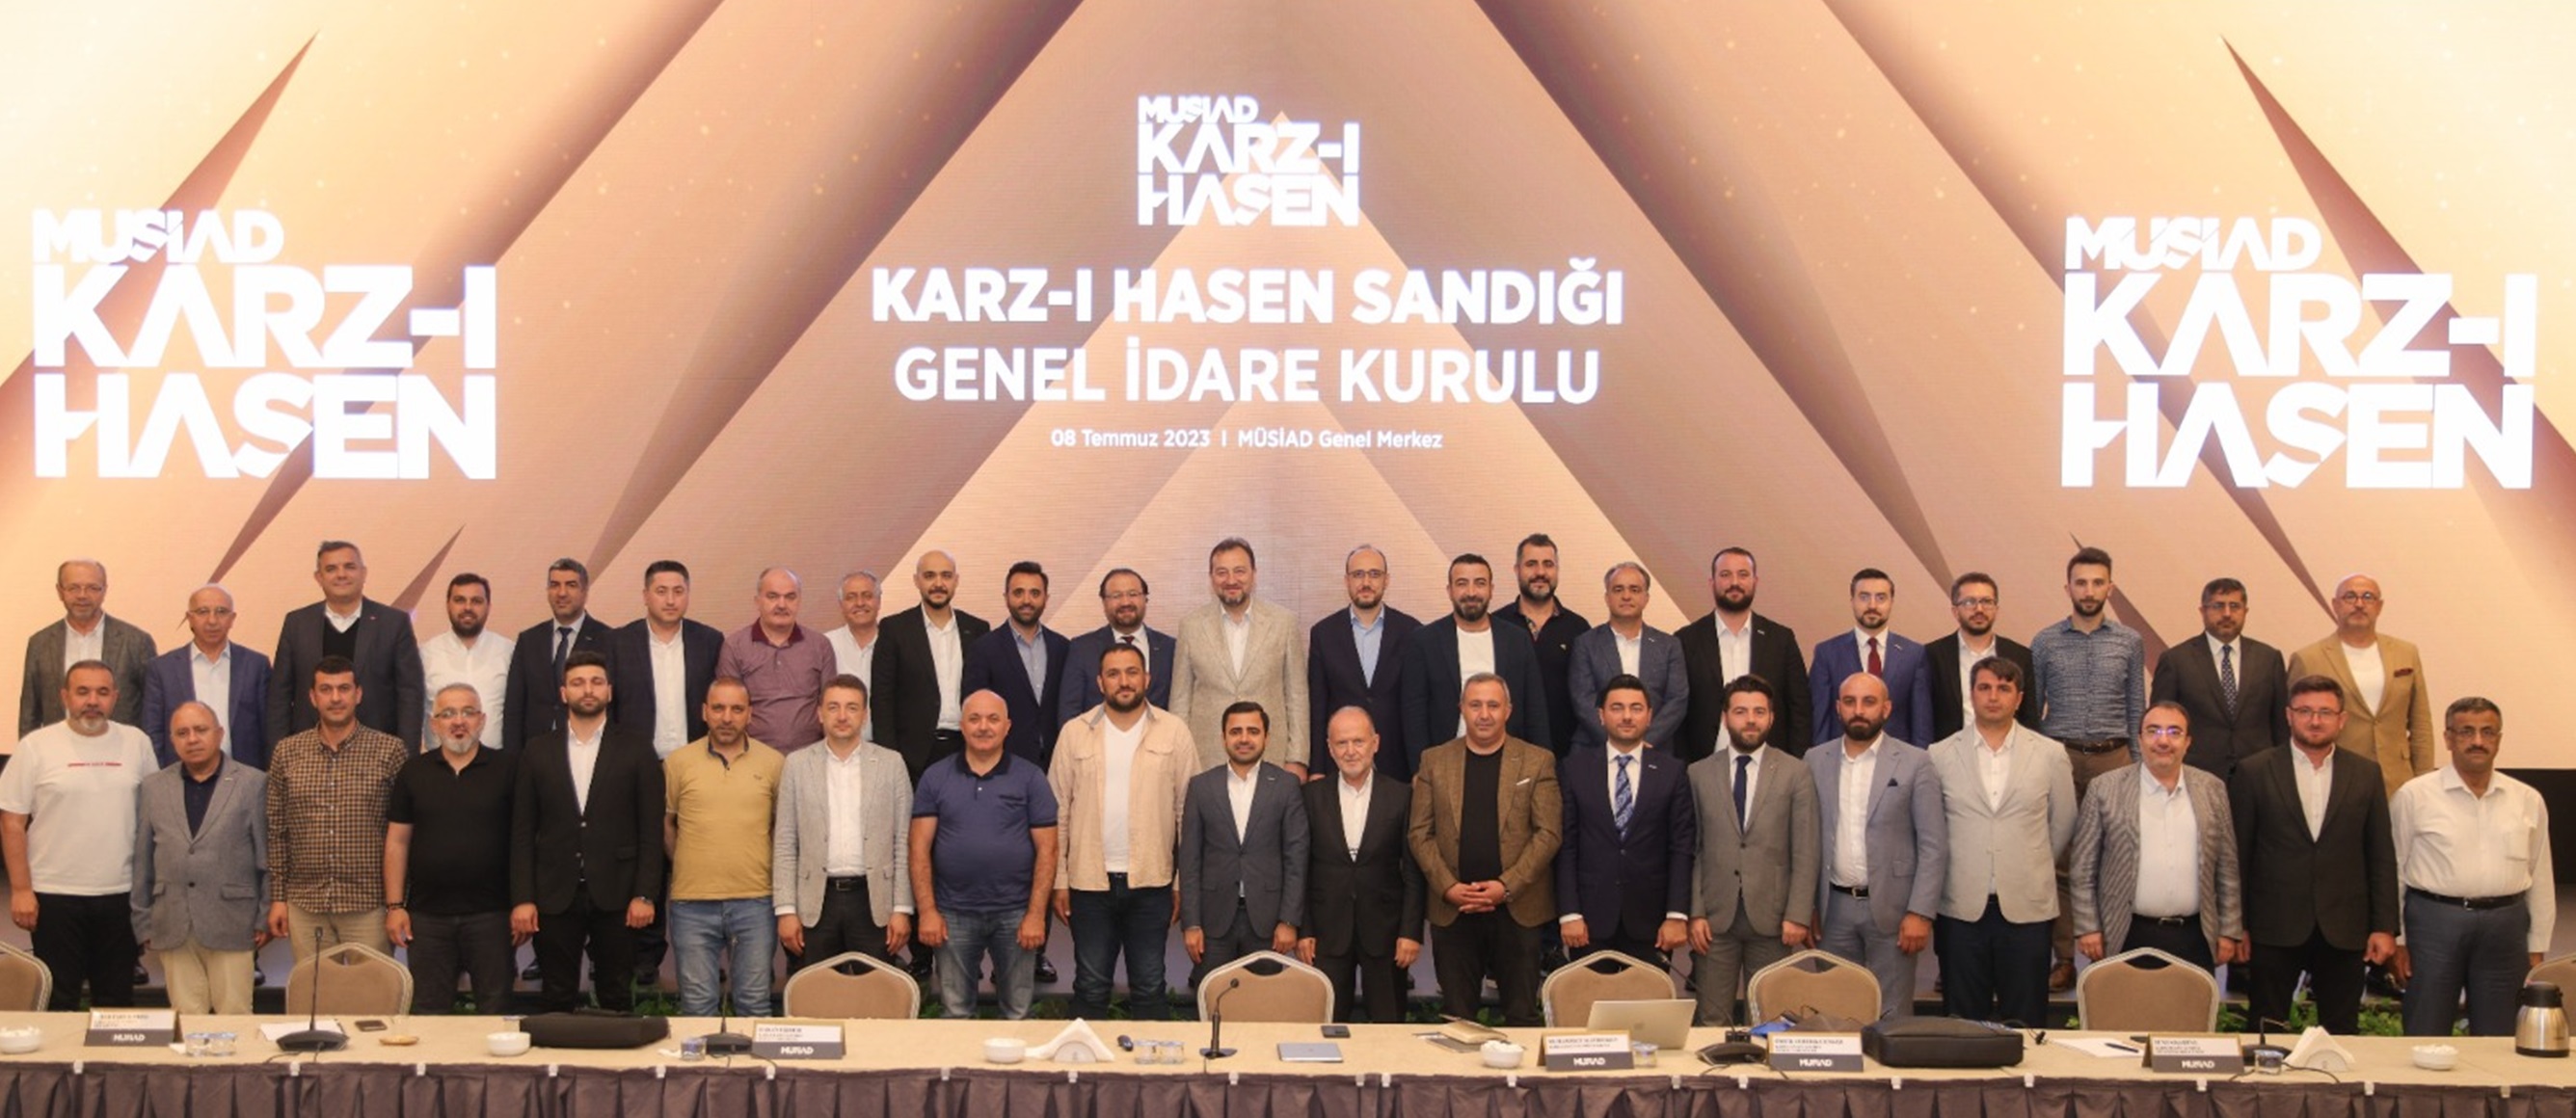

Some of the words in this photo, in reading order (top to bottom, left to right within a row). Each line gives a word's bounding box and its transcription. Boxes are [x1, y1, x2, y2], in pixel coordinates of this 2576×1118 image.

[1139, 123, 1359, 172] KARZ-I
[1139, 174, 1359, 226] HASEN
[34, 264, 495, 368] KARZ-I
[873, 269, 1091, 321] KARZ-I
[1114, 269, 1332, 322] HASEN
[1353, 258, 1622, 324] SANDIĞI
[2065, 273, 2536, 376] KARZ-I
[896, 348, 1104, 400] GENEL
[1127, 336, 1318, 401] İDARE
[1341, 350, 1597, 403] KURULU
[35, 373, 495, 478] HASEN
[1051, 429, 1076, 446] 08
[1082, 429, 1158, 446] Temmuz
[1164, 429, 1211, 447] 2023
[1238, 427, 1313, 447] MÜSİAD
[1319, 430, 1371, 447] Genel
[1378, 431, 1442, 447] Merkez
[2062, 383, 2534, 488] HASEN
